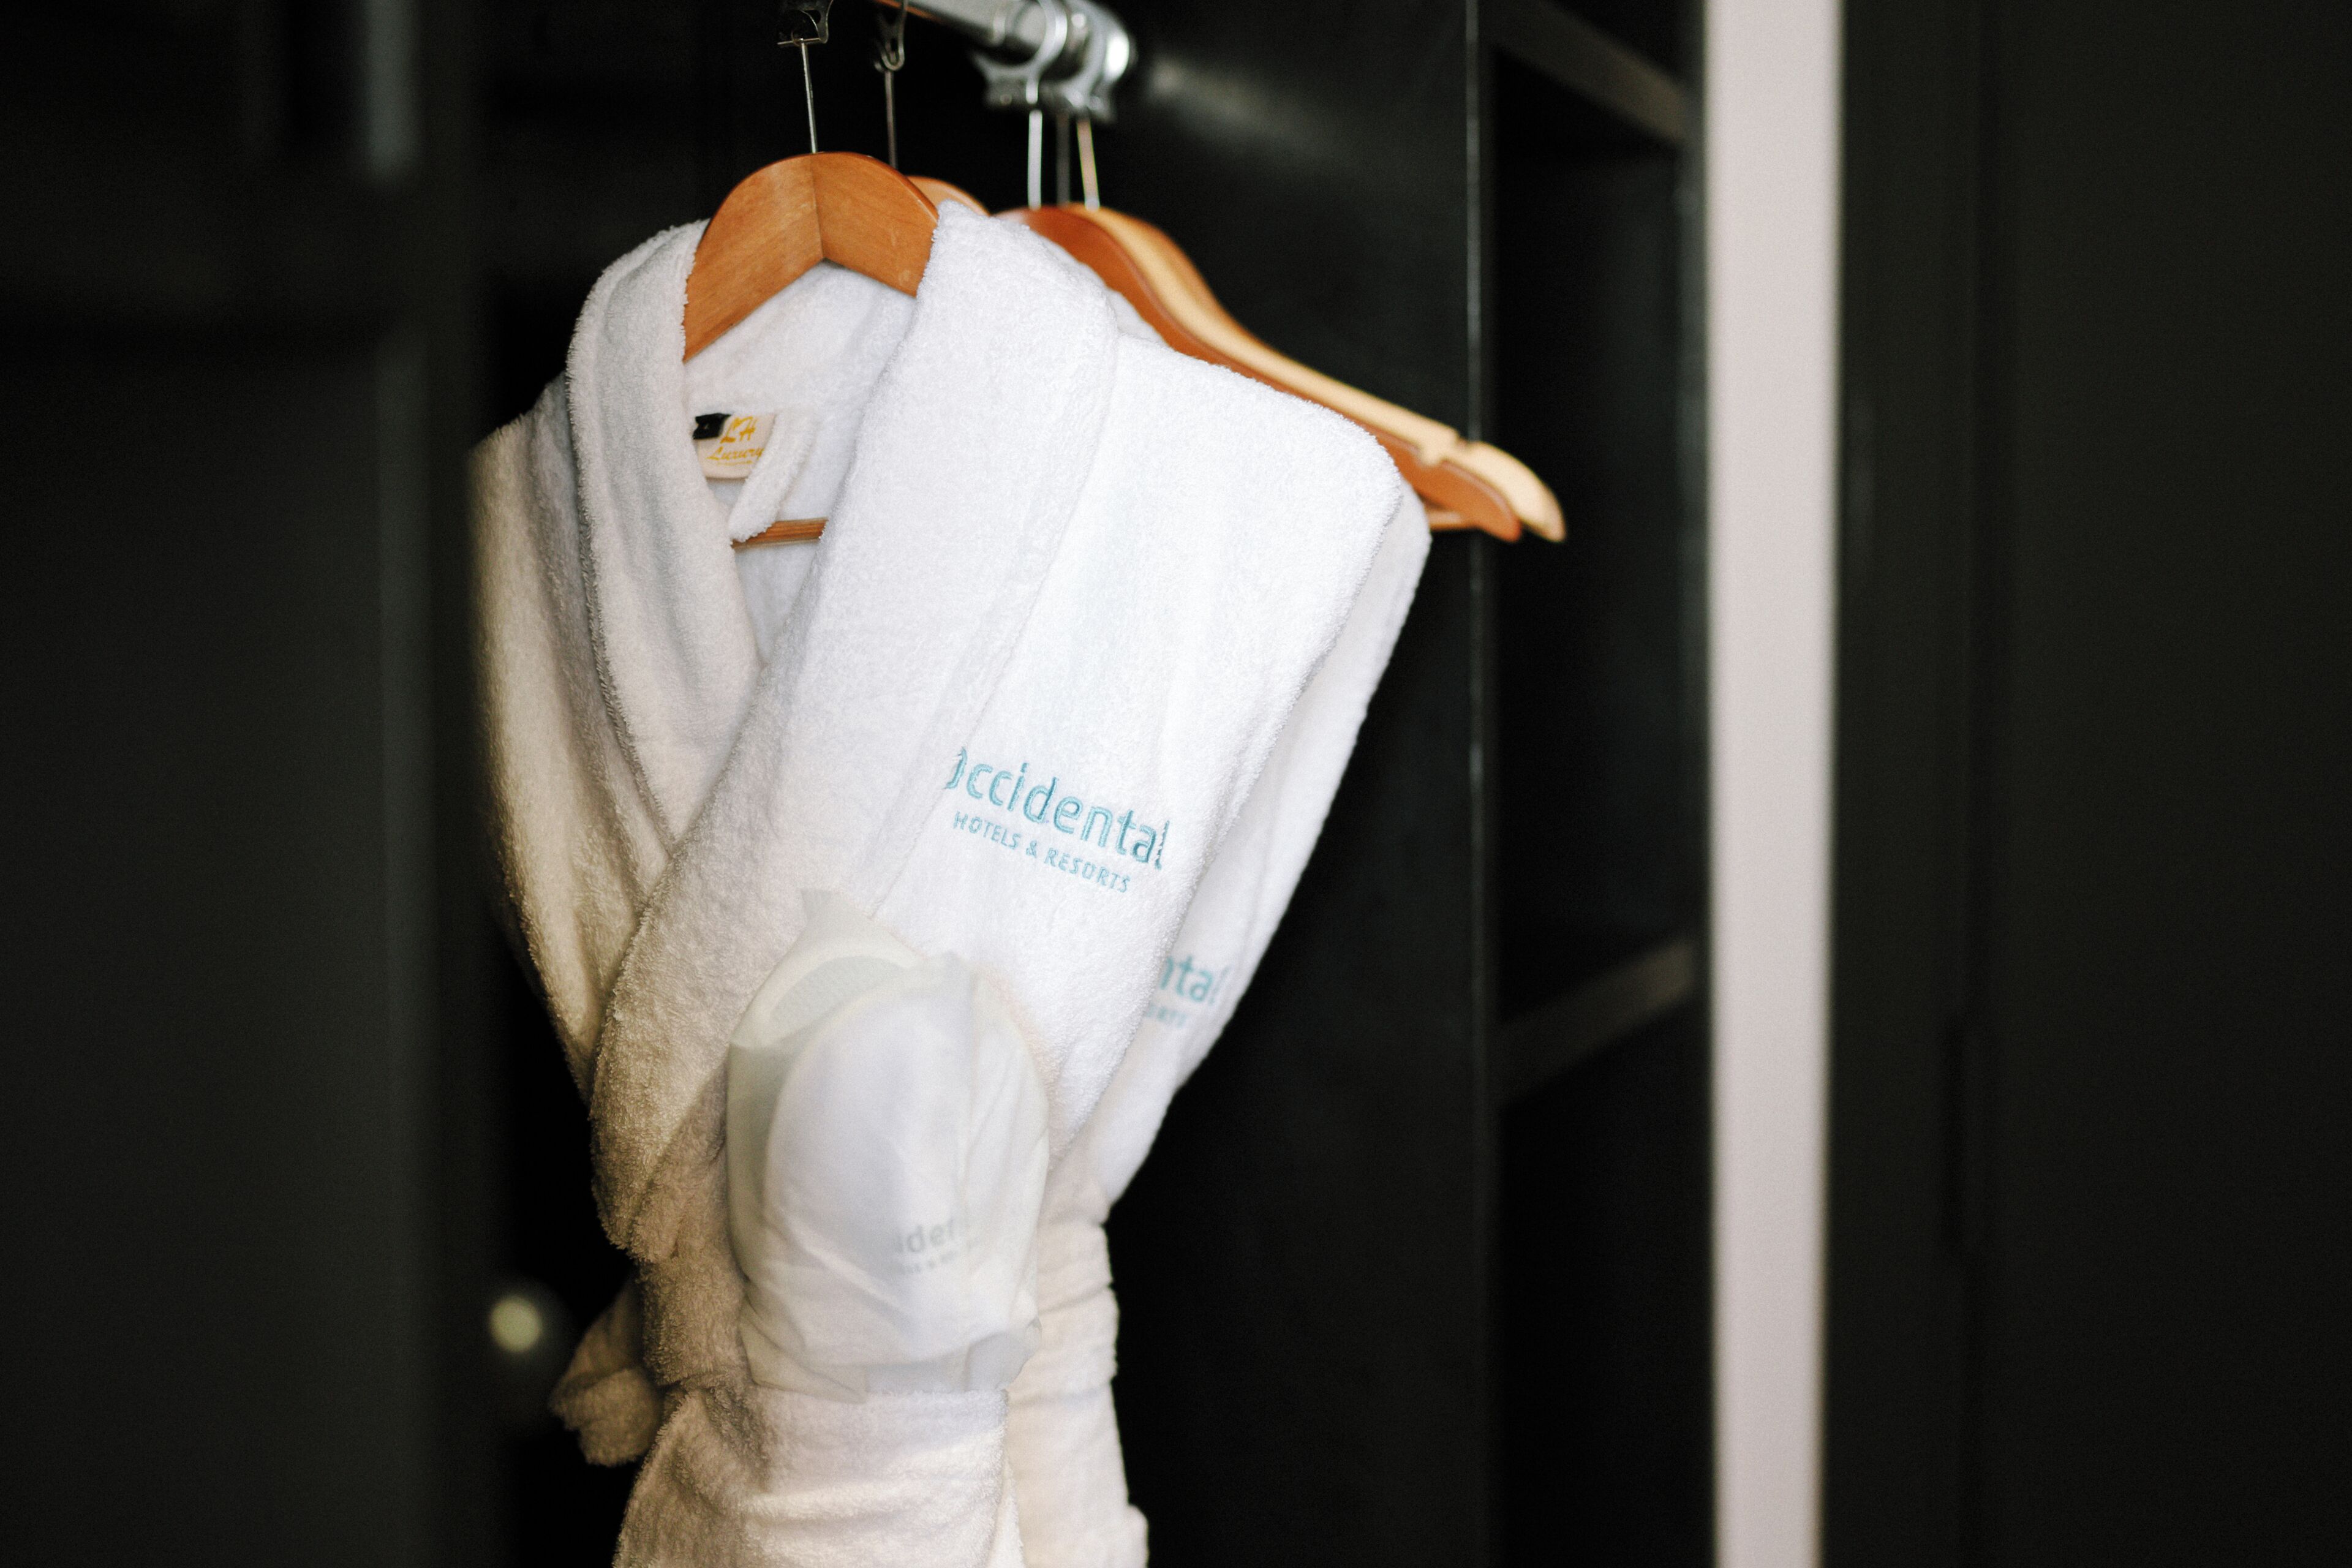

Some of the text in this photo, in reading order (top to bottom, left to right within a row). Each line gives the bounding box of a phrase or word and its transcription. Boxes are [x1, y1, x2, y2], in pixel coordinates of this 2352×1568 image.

[952, 810, 1131, 893] HOTELS & RESORTS
